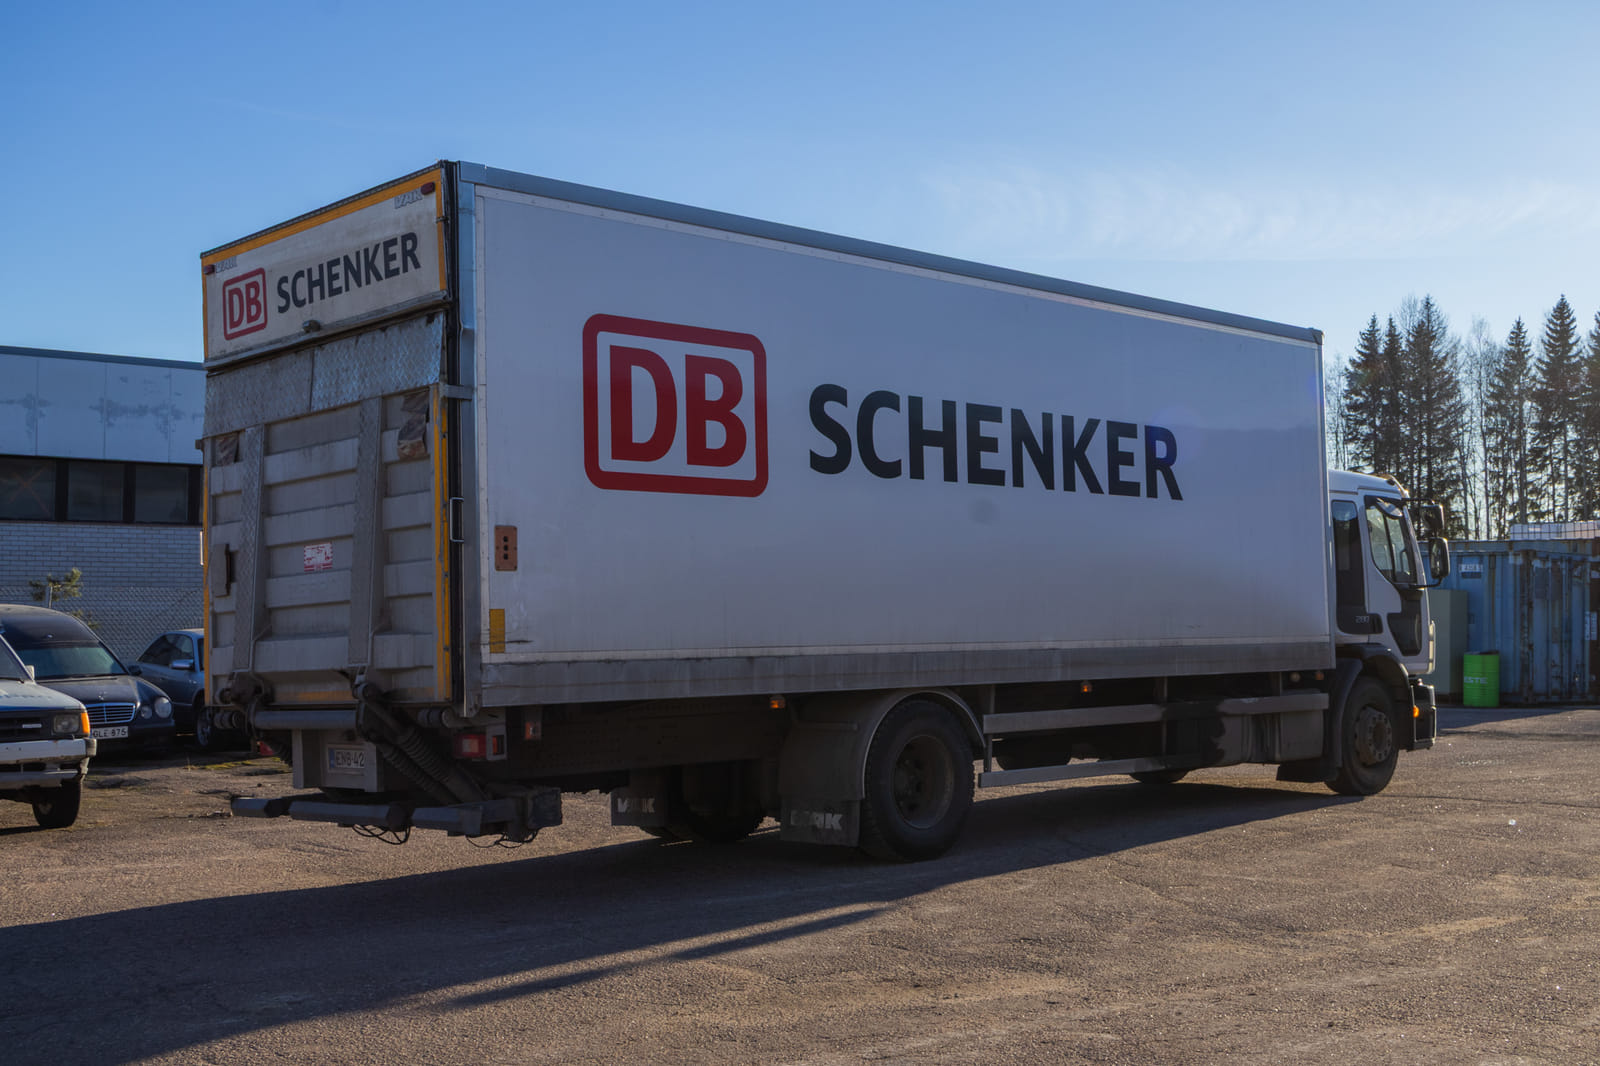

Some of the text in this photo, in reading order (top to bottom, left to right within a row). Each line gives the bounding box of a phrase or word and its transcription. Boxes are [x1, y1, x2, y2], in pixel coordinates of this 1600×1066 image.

[228, 232, 421, 329] DB SCHENKER
[609, 344, 1183, 500] DB SCHENKER
